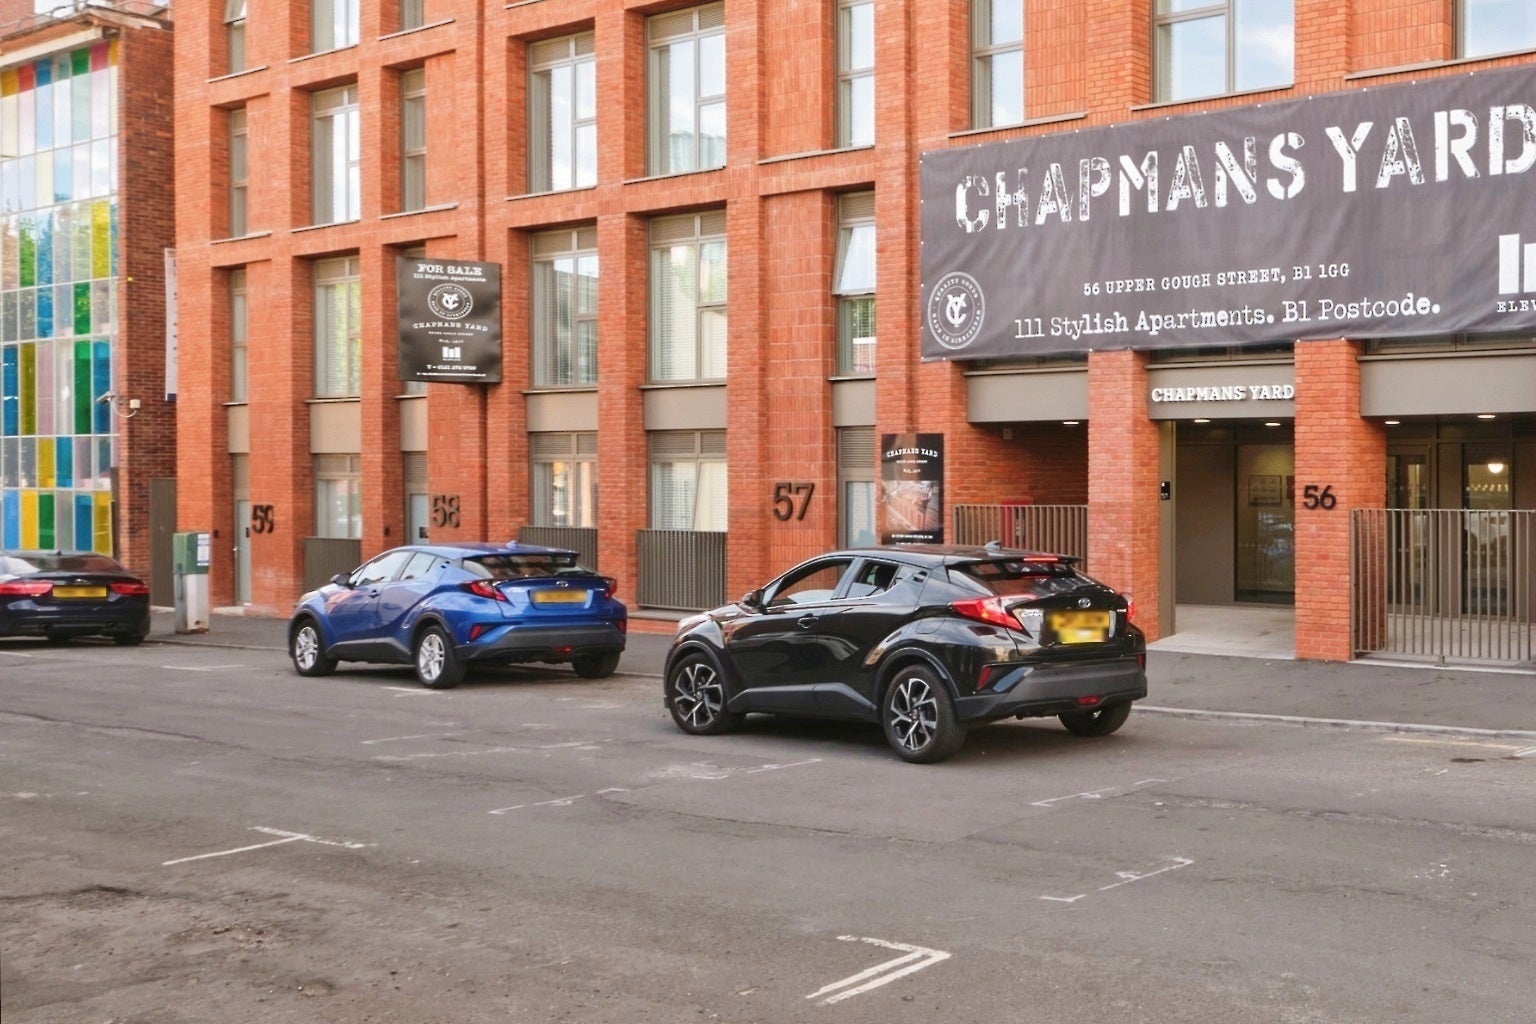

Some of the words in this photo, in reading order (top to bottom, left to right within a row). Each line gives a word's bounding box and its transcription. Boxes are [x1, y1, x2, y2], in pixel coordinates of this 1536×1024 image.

[956, 131, 1305, 233] CHAPMANS
[417, 264, 443, 273] FOR
[447, 266, 482, 275] SALE
[1084, 283, 1100, 295] 56
[1105, 278, 1155, 294] UPPER
[1162, 274, 1210, 290] GOUGH
[1217, 267, 1286, 285] STREET,
[1293, 266, 1310, 280] B1
[1319, 263, 1349, 278] 1GG
[465, 323, 488, 332] YARD
[1014, 318, 1045, 338] 111
[1051, 312, 1129, 340] Stylish
[1135, 307, 1274, 335] Apartments.
[1282, 299, 1310, 323] B1
[1318, 292, 1441, 321] Postcode.
[1151, 385, 1247, 402] CHAPMANS
[1249, 384, 1294, 401] YARD
[921, 448, 938, 458] YARD
[432, 494, 461, 529] 58
[773, 482, 815, 522] 57
[1303, 485, 1337, 511] 56
[251, 504, 275, 534] 59
